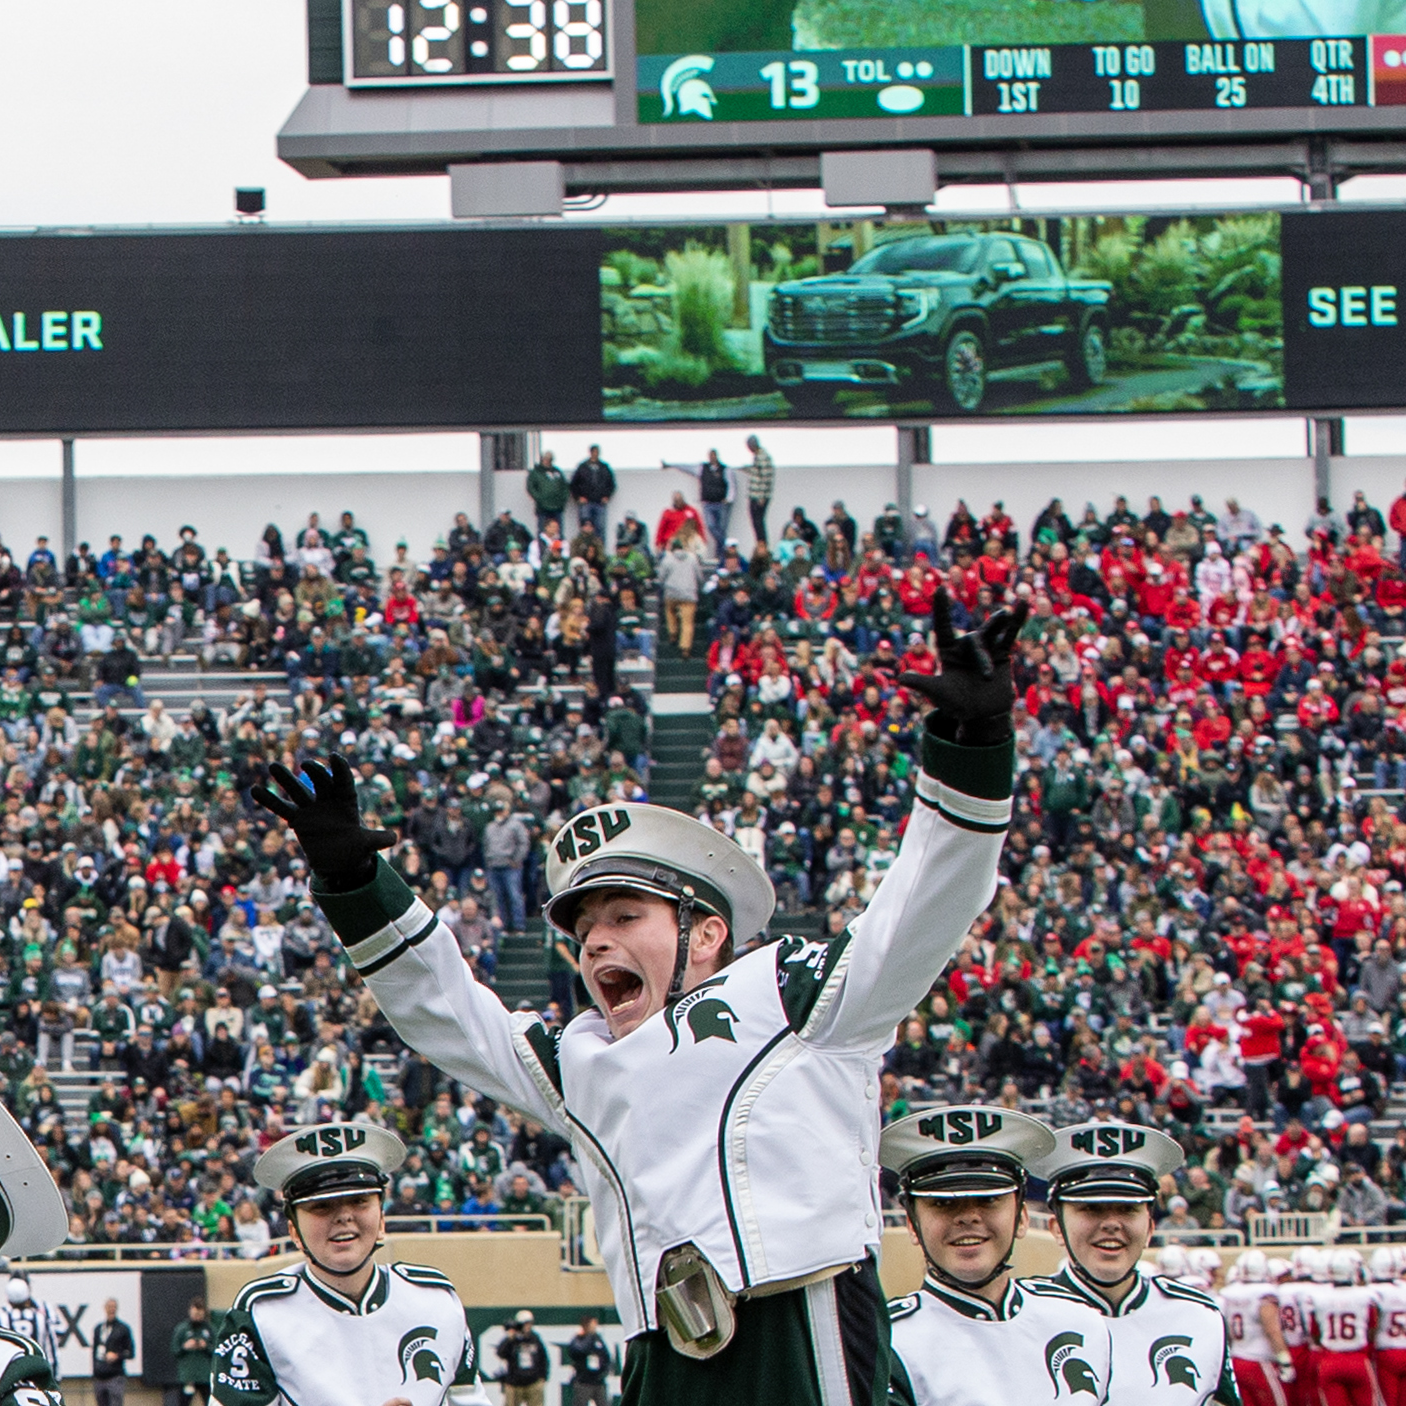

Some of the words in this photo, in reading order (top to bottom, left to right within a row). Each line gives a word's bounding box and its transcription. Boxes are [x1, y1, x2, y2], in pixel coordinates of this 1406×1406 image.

[389, 0, 603, 72] 12:38
[842, 60, 892, 83] TOL
[983, 48, 1051, 79] DOWN
[1092, 46, 1120, 76] TO
[1125, 45, 1155, 76] GO
[1185, 44, 1241, 75] BALL
[1244, 43, 1275, 73] ON
[1310, 39, 1354, 74] QTR
[760, 61, 820, 110] 13
[997, 82, 1040, 113] 1ST
[1108, 80, 1140, 110] 10
[1215, 77, 1247, 108] 25
[1310, 74, 1355, 106] 4TH
[1308, 285, 1399, 328] SEE
[555, 809, 632, 864] MSU
[295, 1127, 366, 1157] MSU
[918, 1110, 1003, 1145] MSU
[1071, 1126, 1146, 1158] MSU
[1327, 1312, 1357, 1340] 16
